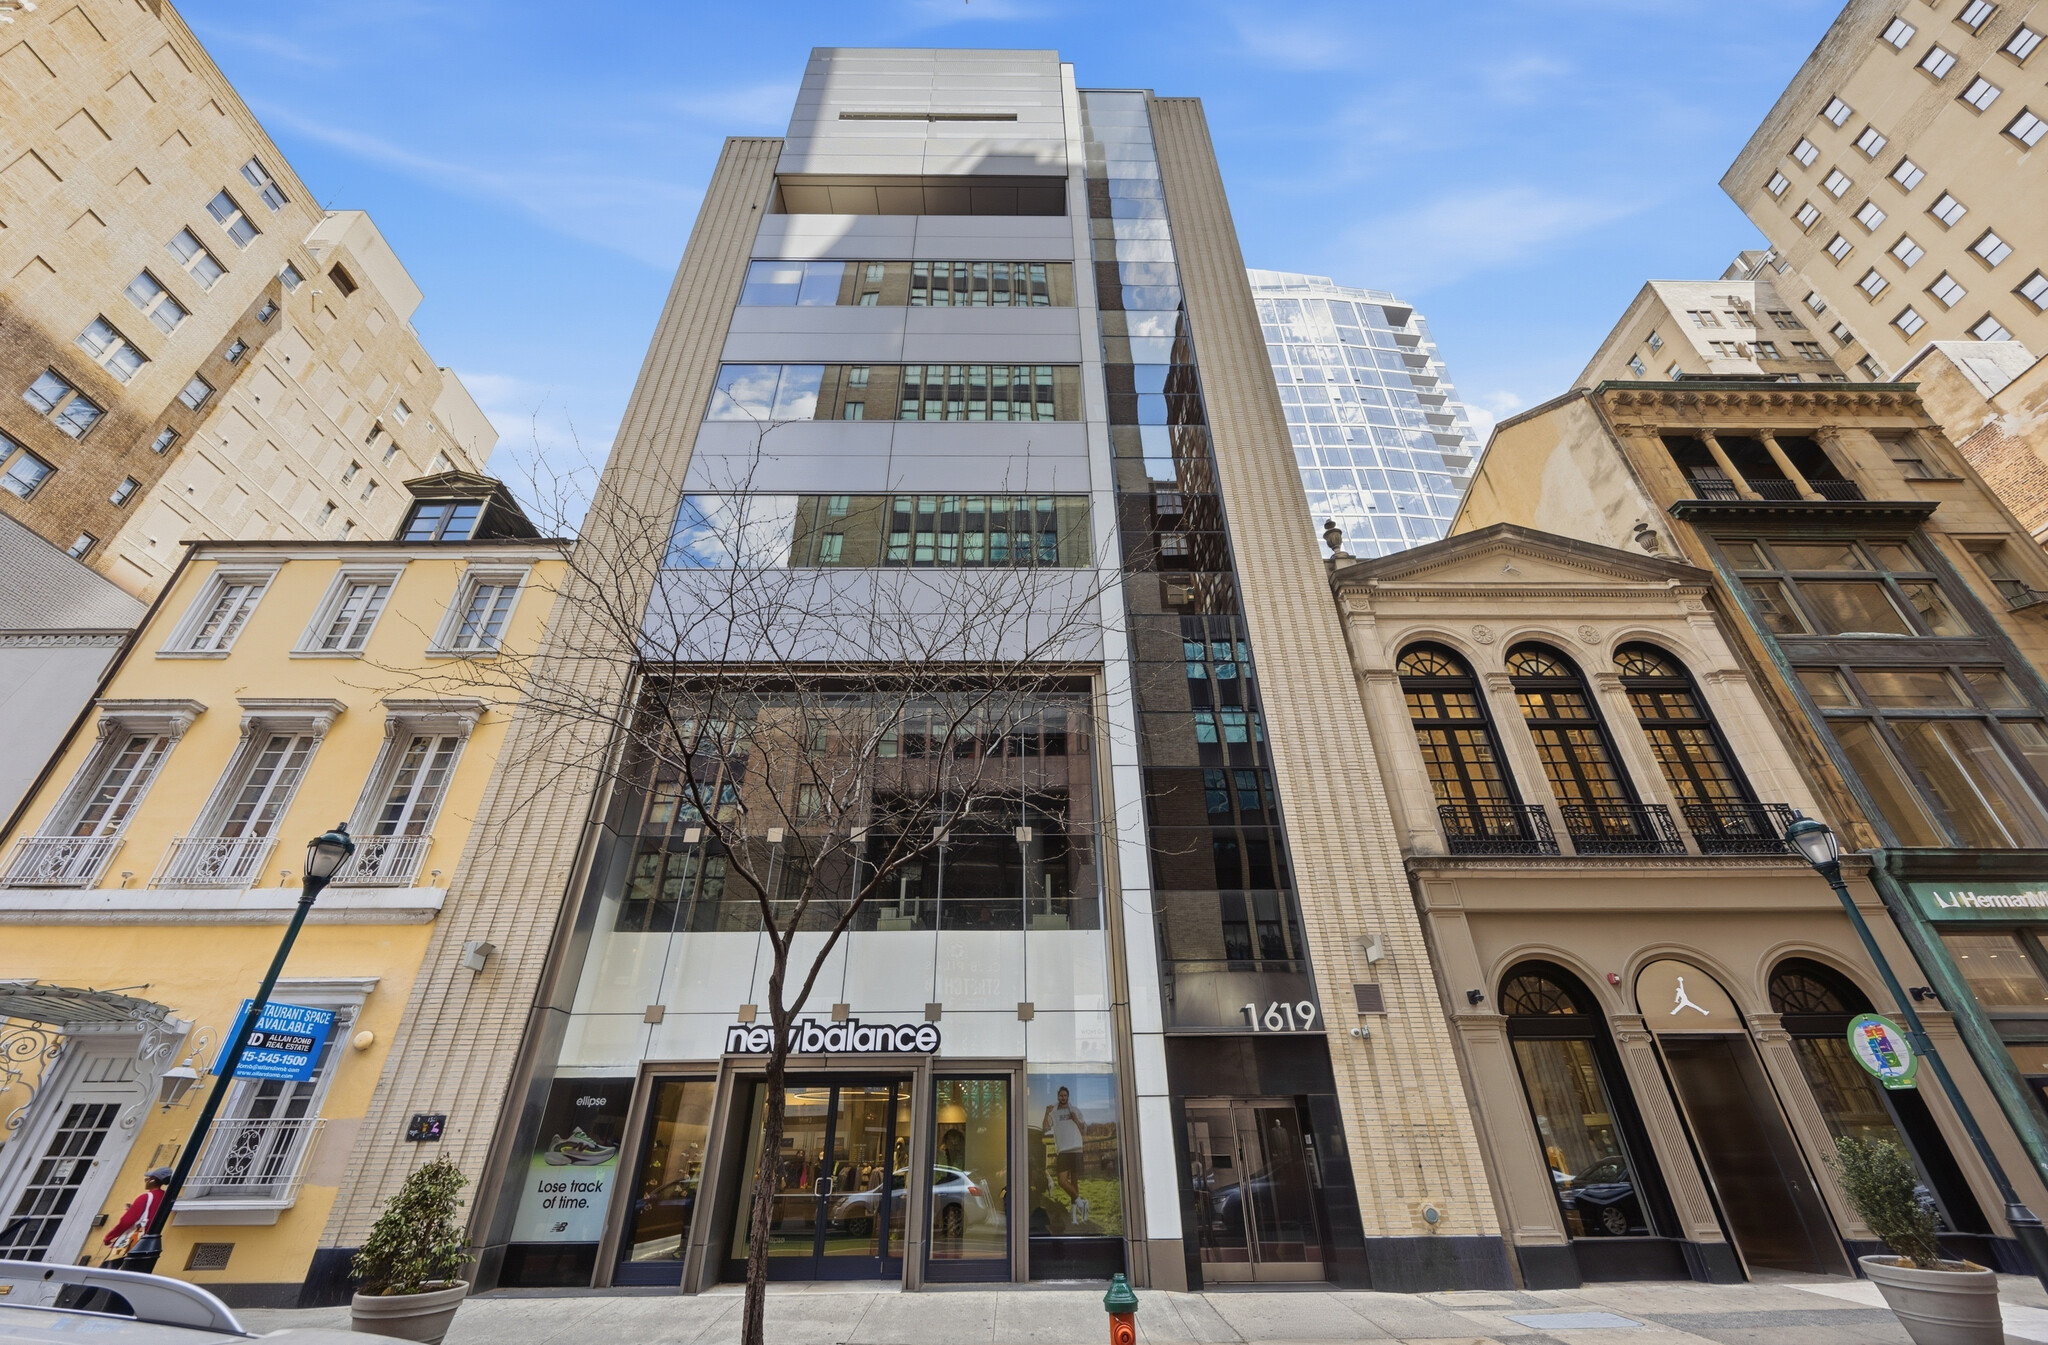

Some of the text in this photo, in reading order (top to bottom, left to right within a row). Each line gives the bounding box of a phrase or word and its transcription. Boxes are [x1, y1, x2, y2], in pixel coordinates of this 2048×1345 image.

[1958, 891, 2048, 908] HermanM
[304, 1010, 332, 1025] SPACE
[1246, 1001, 1316, 1031] 1619
[254, 1017, 314, 1034] AVAILABLE
[269, 1034, 312, 1045] ALLAN DOMB
[801, 1021, 938, 1052] balance
[266, 1041, 310, 1052] REAL ESTATE
[242, 1051, 307, 1066] 15-545-1500
[576, 1096, 607, 1108] ellipse
[538, 1180, 603, 1193] Lose track
[543, 1196, 589, 1209] of time.
